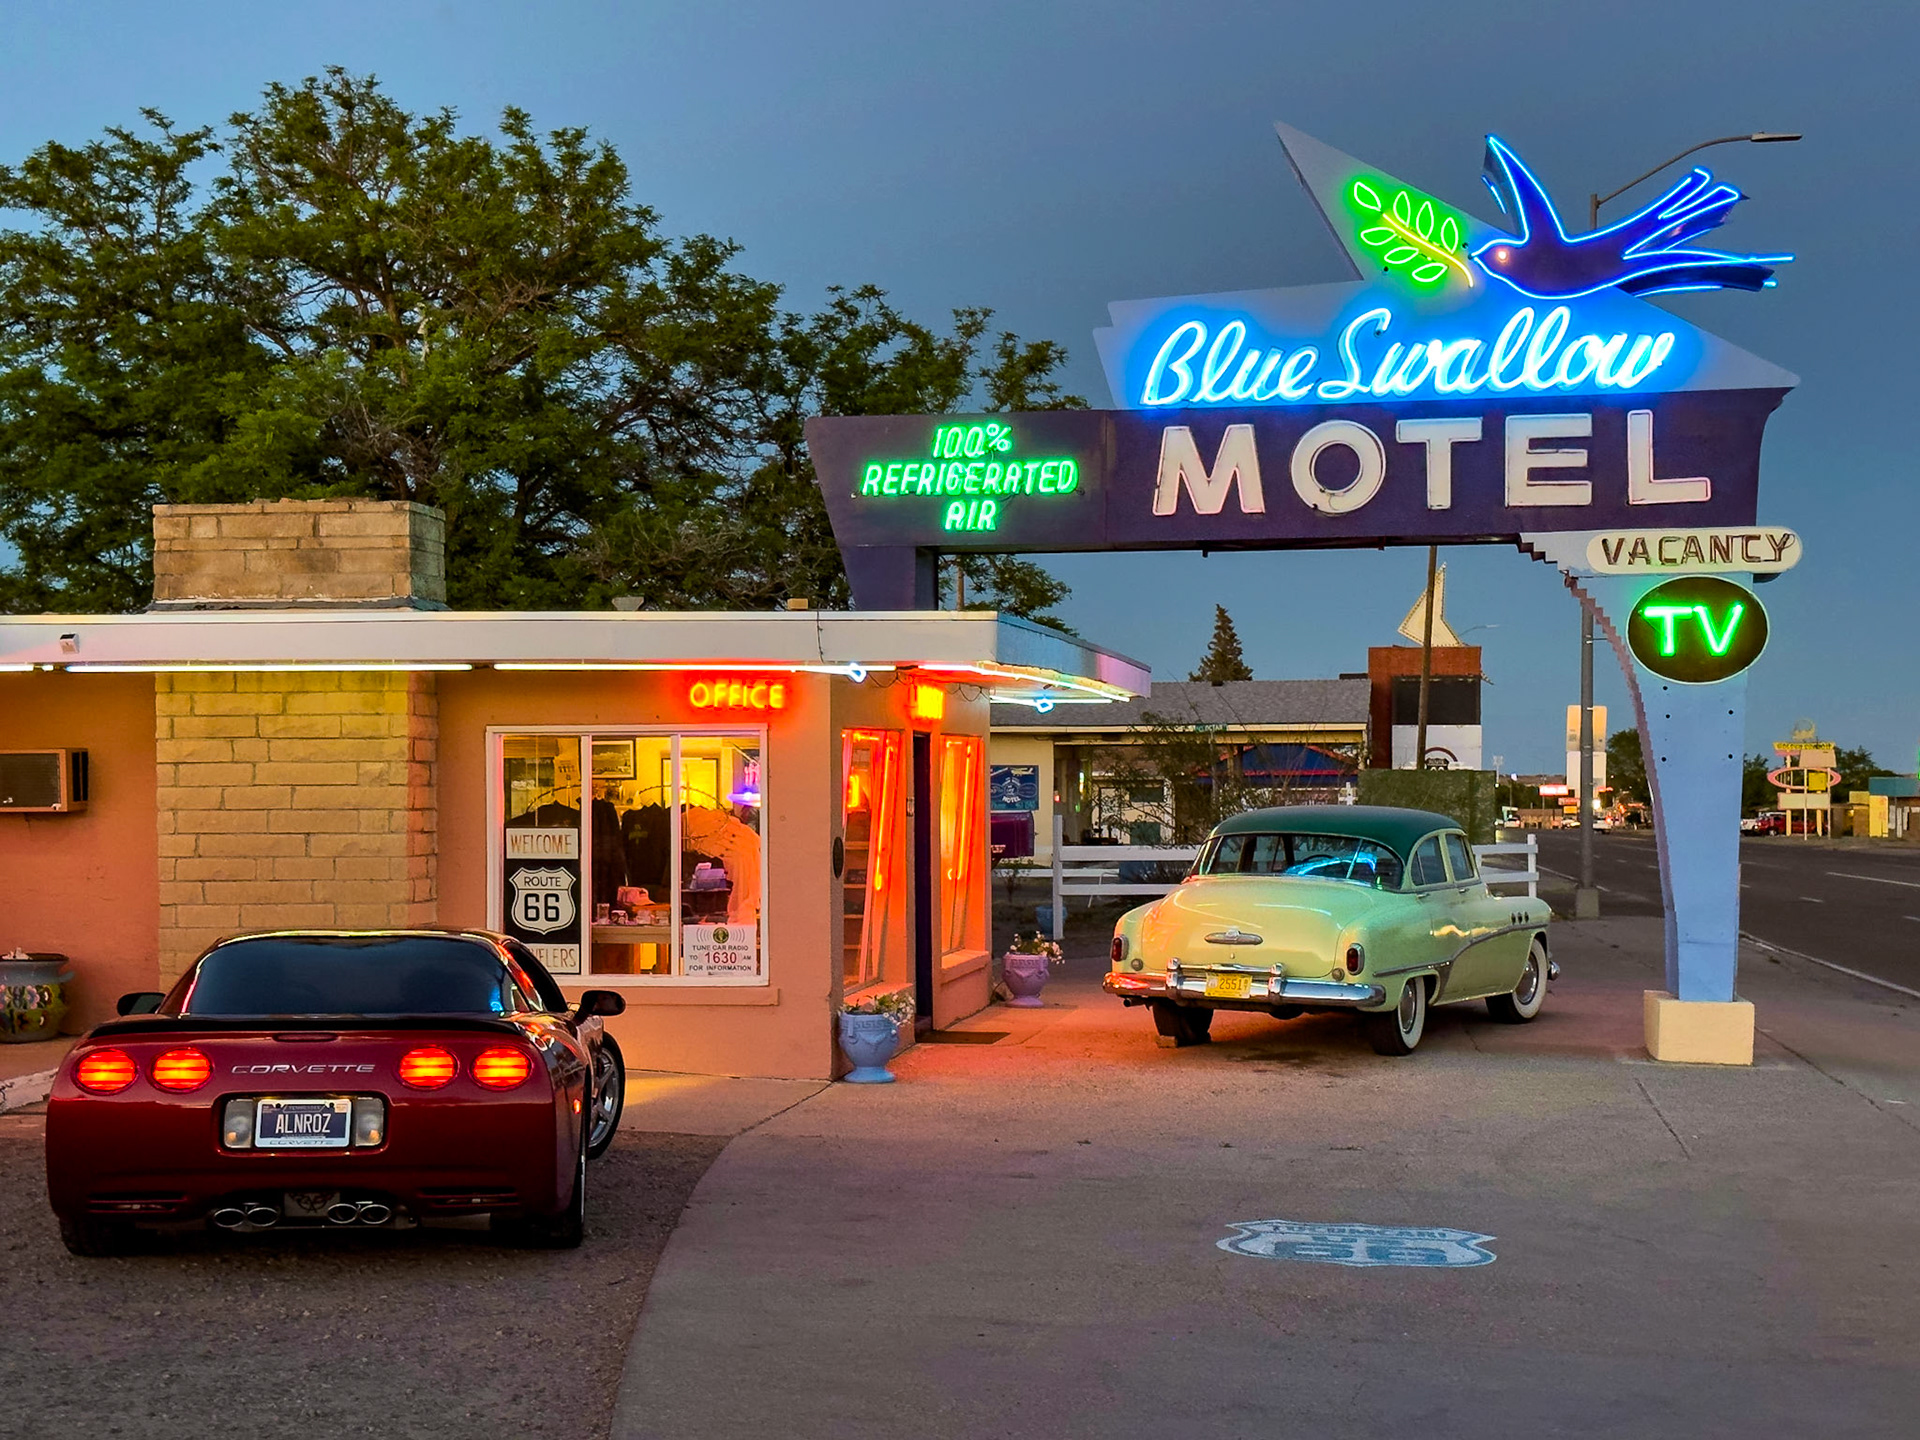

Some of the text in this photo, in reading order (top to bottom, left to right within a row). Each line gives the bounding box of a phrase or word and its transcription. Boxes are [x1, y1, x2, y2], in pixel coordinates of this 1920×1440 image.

[1141, 306, 1676, 406] Blue Swallow
[931, 423, 1013, 459] 100%
[1152, 409, 1711, 515] MOTEL
[860, 460, 1079, 496] REFRIGERATED
[943, 500, 998, 532] AIR
[1602, 533, 1793, 566] VACANCY
[1641, 602, 1744, 657] TV
[689, 682, 785, 709] OFFICE
[510, 834, 573, 855] WELCOME
[523, 876, 562, 887] ROUTE
[524, 893, 560, 922] 66
[704, 951, 737, 964] 1630
[1219, 979, 1242, 991] 2551
[231, 1063, 376, 1074] CORVETTE
[275, 1112, 332, 1134] ALNROZ
